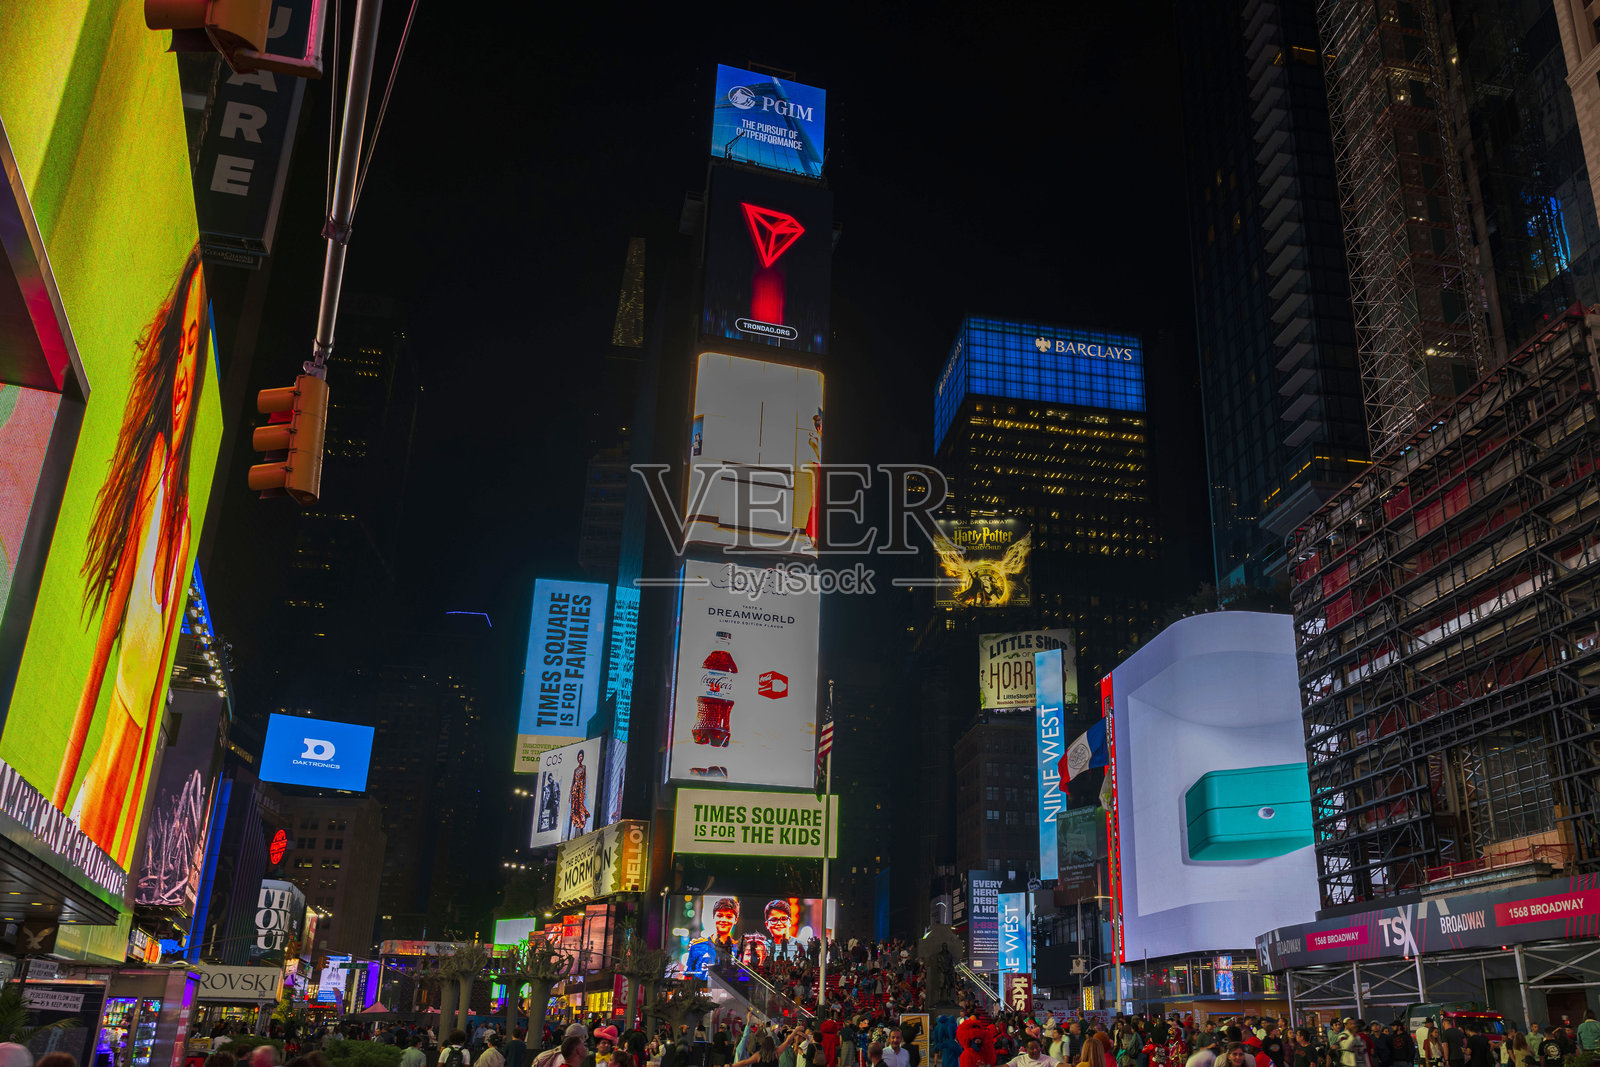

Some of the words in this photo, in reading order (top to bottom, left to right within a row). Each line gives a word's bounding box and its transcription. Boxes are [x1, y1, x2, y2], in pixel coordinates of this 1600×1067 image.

[762, 96, 814, 122] PGIM
[736, 127, 803, 151] OUTPERFORMANCE
[742, 119, 756, 131] THE
[757, 123, 788, 137] PURSUIT
[788, 129, 799, 140] OF
[1054, 340, 1133, 361] BARCLAYS
[952, 529, 982, 545] Harry
[982, 527, 1013, 546] Potter
[708, 607, 795, 624] DREAMWORLD
[543, 592, 571, 667] SQUARE
[564, 594, 592, 679] FAMILIES
[989, 634, 1033, 659] LITTLE
[536, 671, 561, 727] TIMES
[561, 683, 577, 709] FOR
[559, 713, 574, 726] IS
[1041, 704, 1060, 764] WEST
[545, 753, 562, 767] COS
[1042, 769, 1062, 823] NINE
[694, 804, 747, 824] TIMES
[751, 806, 822, 827] SQUARE
[694, 824, 706, 836] IS
[711, 825, 735, 838] FOR
[741, 825, 774, 844] THE
[779, 827, 821, 846] KIDS
[625, 824, 644, 889] HELLO!
[973, 880, 1004, 888] EVERY
[973, 888, 999, 897] HERO
[973, 905, 980, 913] A
[1508, 908, 1529, 919] 1568
[1530, 898, 1585, 916] BROADWAY
[1004, 904, 1020, 953] WEST
[1314, 936, 1327, 945] 1568
[1327, 931, 1359, 944] BROADWAY
[1378, 904, 1419, 956] TSX
[1439, 910, 1486, 935] BROADWAY
[1012, 977, 1029, 1011] tkts
